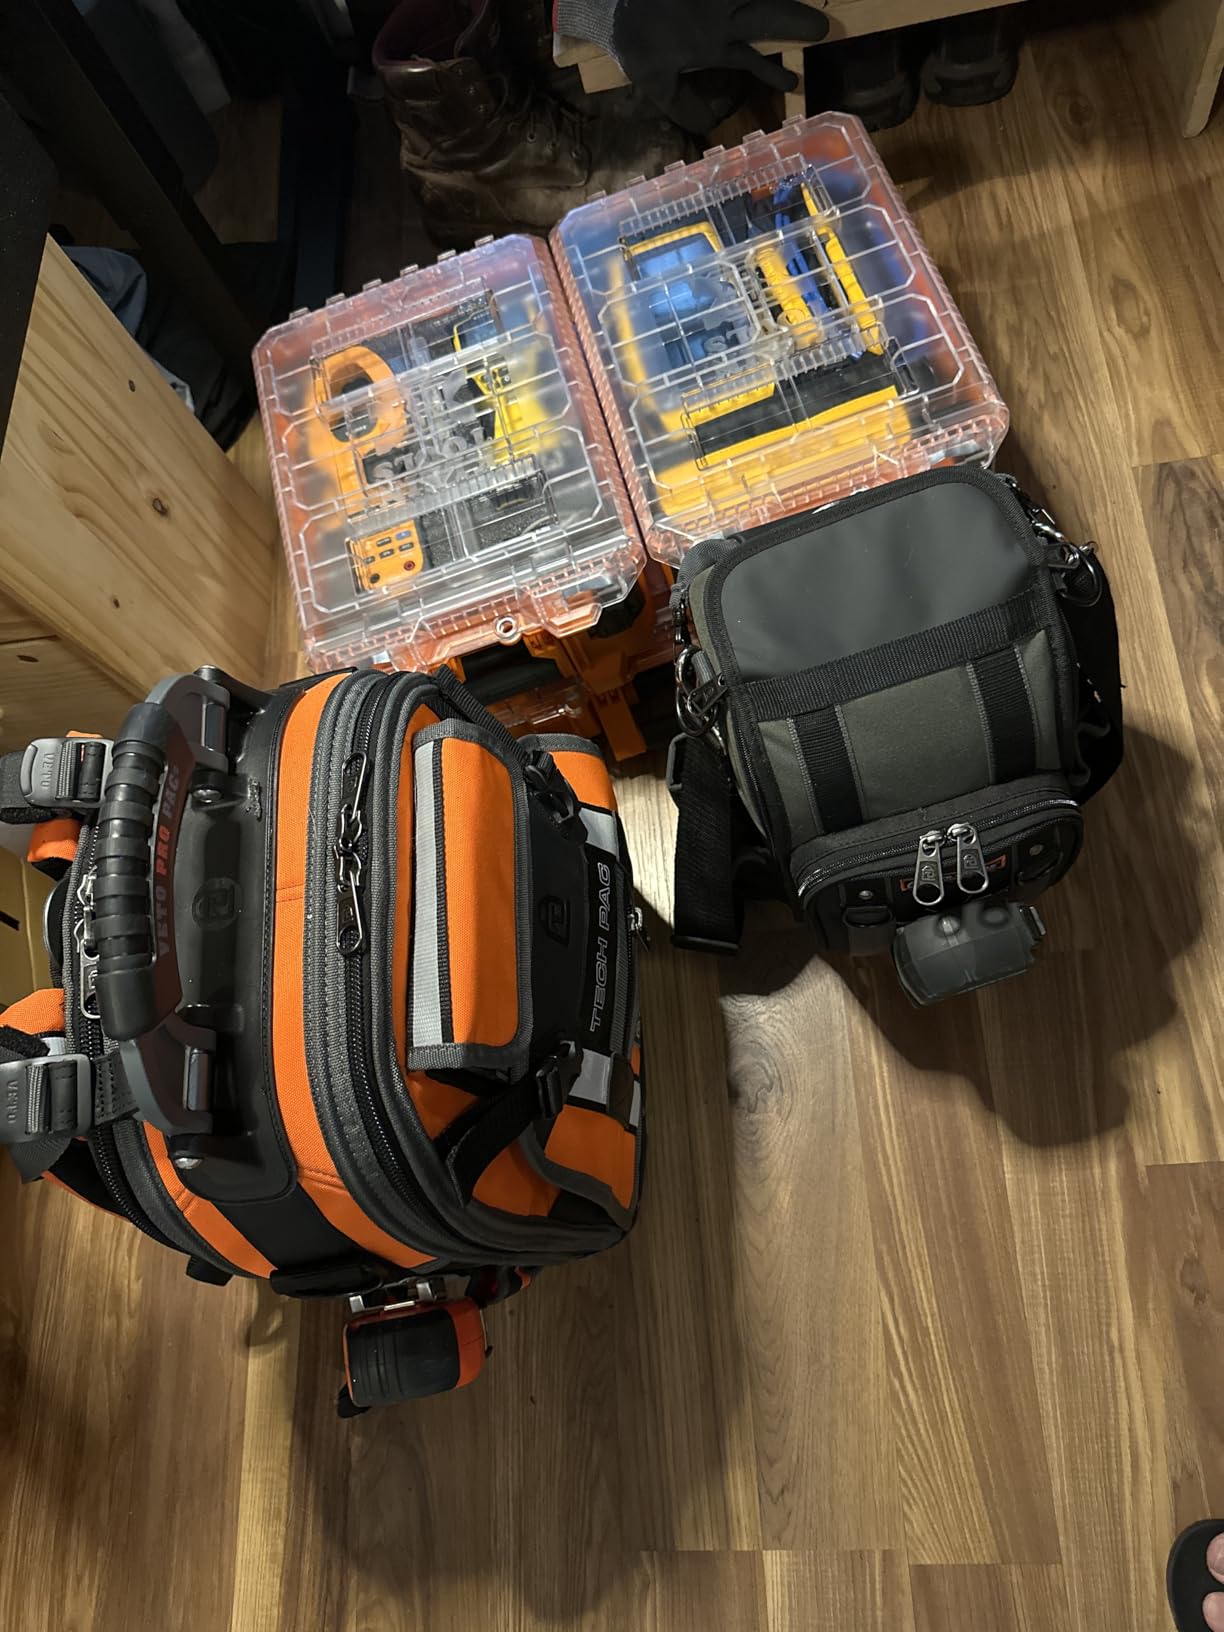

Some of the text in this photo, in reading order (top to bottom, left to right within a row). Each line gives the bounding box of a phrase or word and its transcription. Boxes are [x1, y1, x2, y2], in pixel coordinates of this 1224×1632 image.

[40, 752, 55, 790] VETO
[155, 824, 171, 876] PRO
[155, 885, 170, 957] VETO
[589, 862, 611, 1032] TECH PAC
[7, 1080, 18, 1124] VETO
